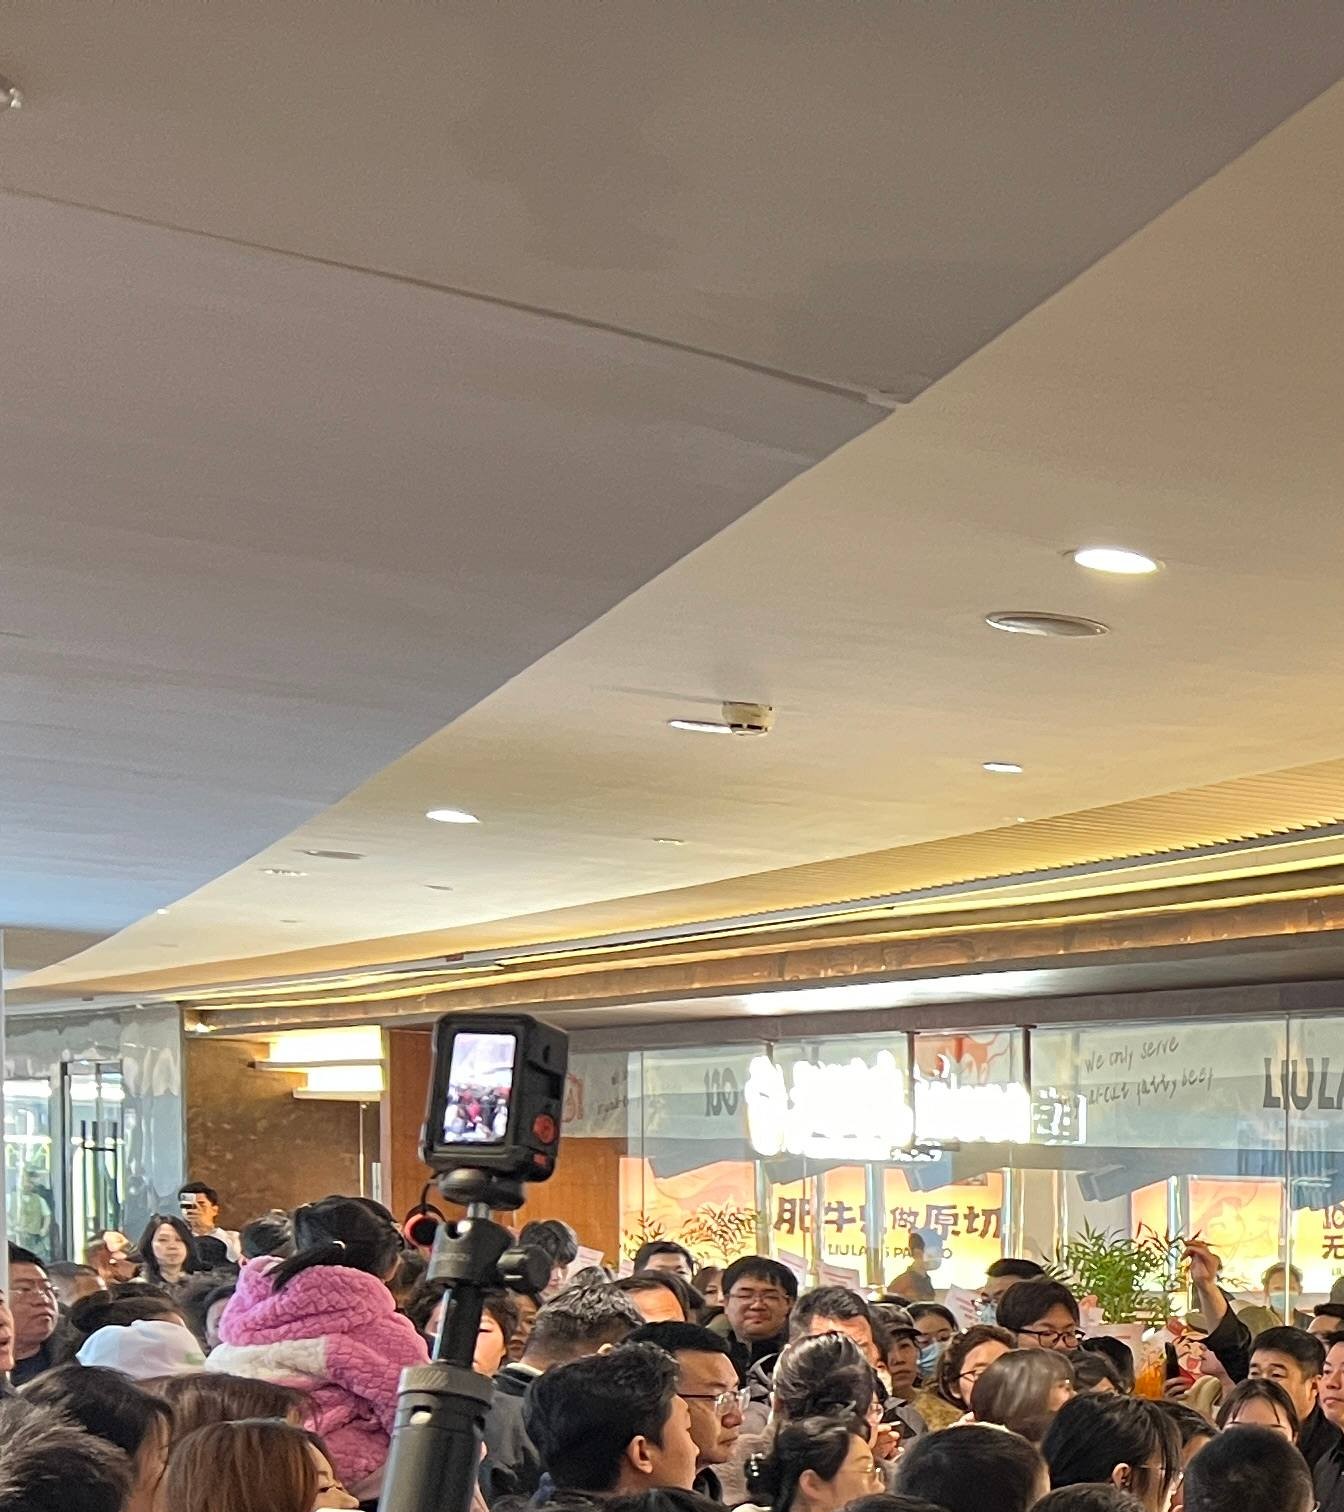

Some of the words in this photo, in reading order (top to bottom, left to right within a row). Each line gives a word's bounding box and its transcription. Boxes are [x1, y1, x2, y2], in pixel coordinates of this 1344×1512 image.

[773, 1197, 1001, 1240] 肥牛做原切
